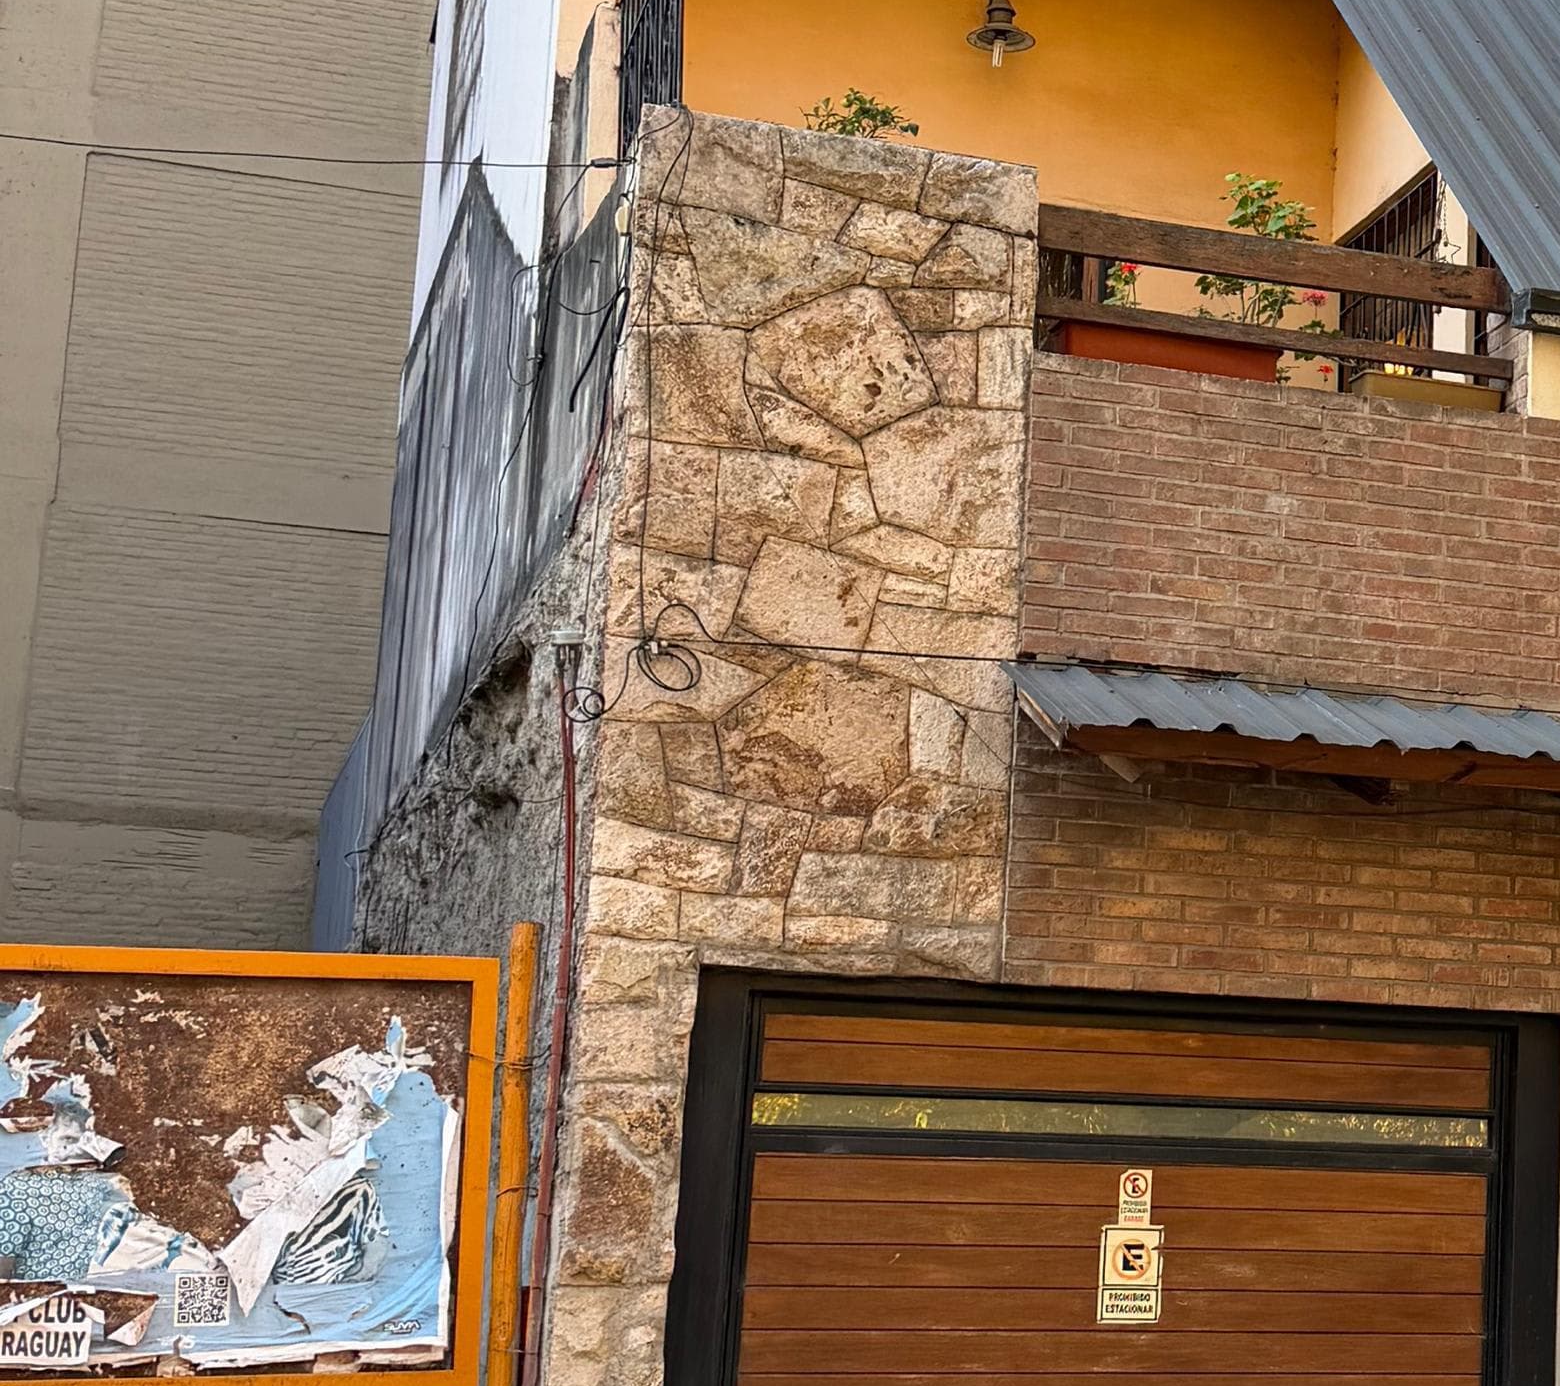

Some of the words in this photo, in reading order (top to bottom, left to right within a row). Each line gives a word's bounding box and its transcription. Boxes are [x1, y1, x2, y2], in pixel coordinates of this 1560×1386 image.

[1109, 1292, 1151, 1302] PROHIBIDO
[1105, 1303, 1154, 1314] ESTACIONAR
[1, 1330, 87, 1358] RAGUAY
